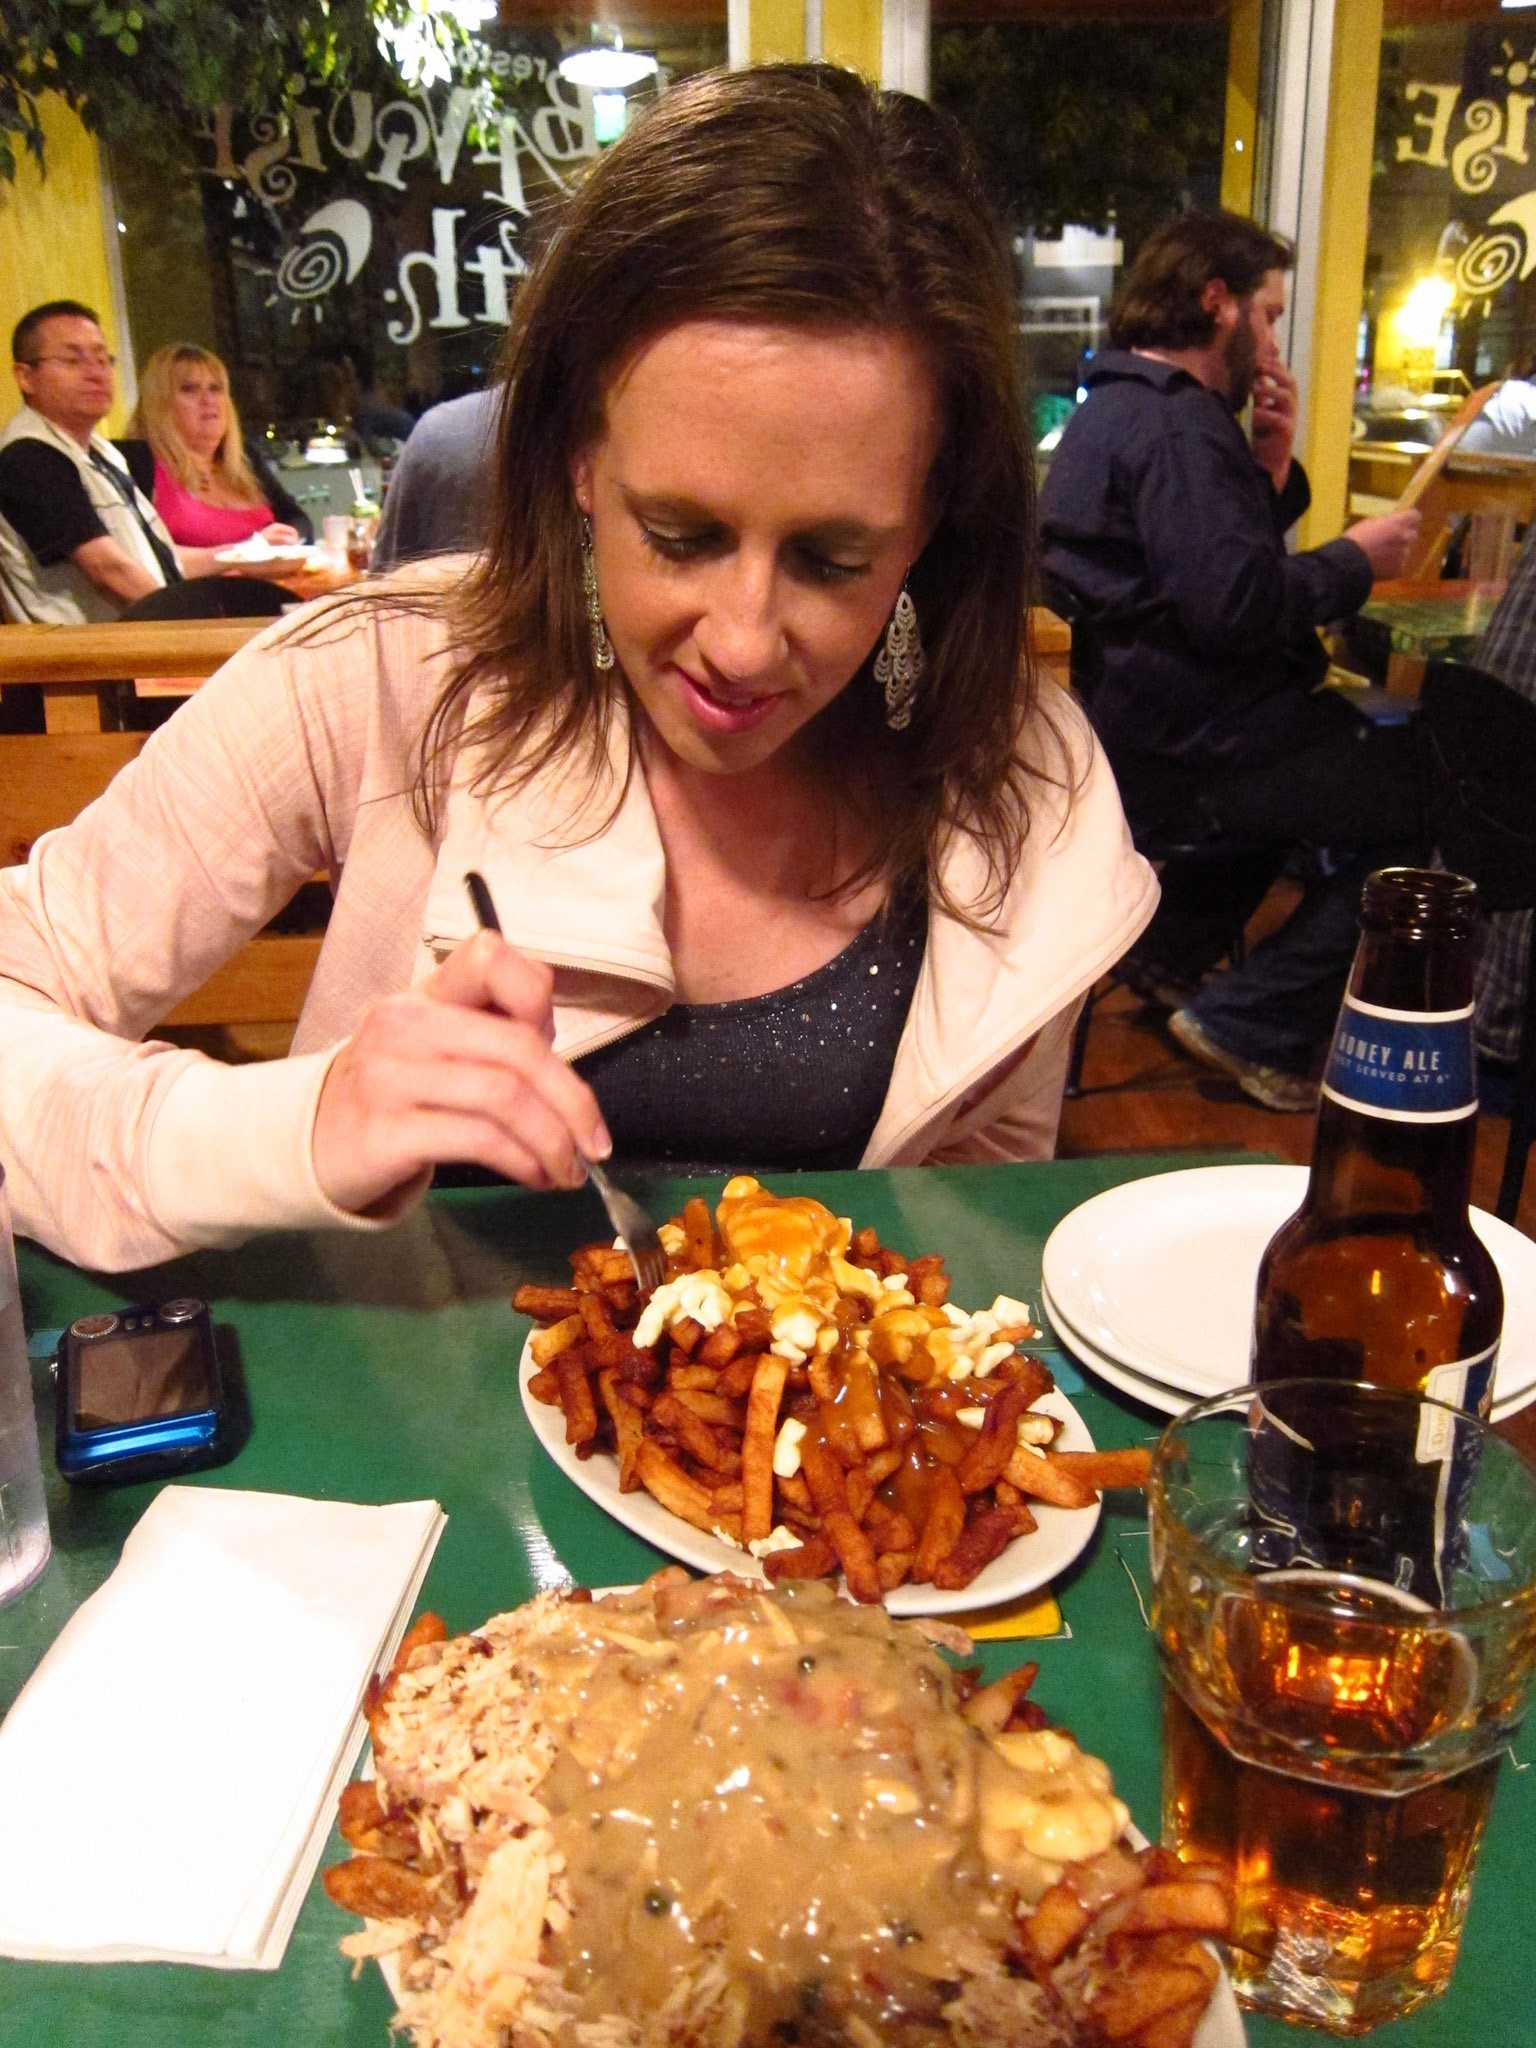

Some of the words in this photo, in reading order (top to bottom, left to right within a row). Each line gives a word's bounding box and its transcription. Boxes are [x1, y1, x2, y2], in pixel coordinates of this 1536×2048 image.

[1403, 1049, 1440, 1072] ALE
[1355, 1062, 1407, 1084] SERVED
[1412, 1074, 1430, 1084] AT
